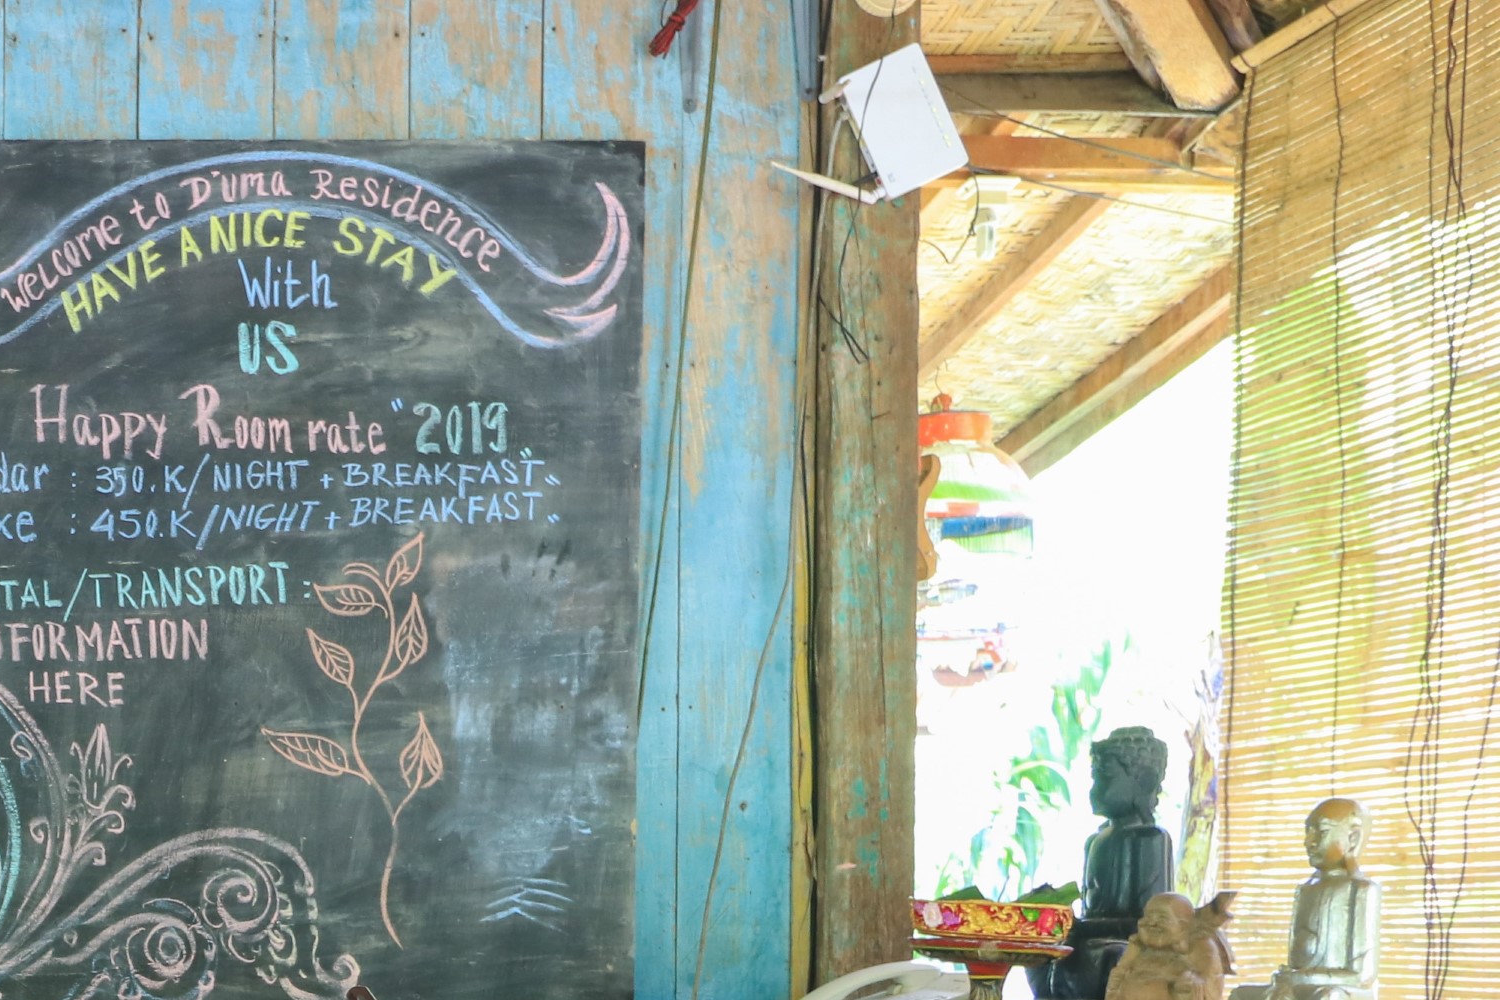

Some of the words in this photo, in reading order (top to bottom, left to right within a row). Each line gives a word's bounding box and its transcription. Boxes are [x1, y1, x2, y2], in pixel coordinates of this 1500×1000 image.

[129, 192, 171, 230] to
[309, 169, 500, 272] Residence
[61, 240, 166, 334] HAVE
[181, 226, 203, 267] A
[210, 209, 311, 254] NICE
[332, 217, 458, 296] STAY
[238, 320, 299, 375] US
[28, 383, 168, 460] Happy
[307, 411, 387, 455] rate
[28, 671, 125, 707] HERE
